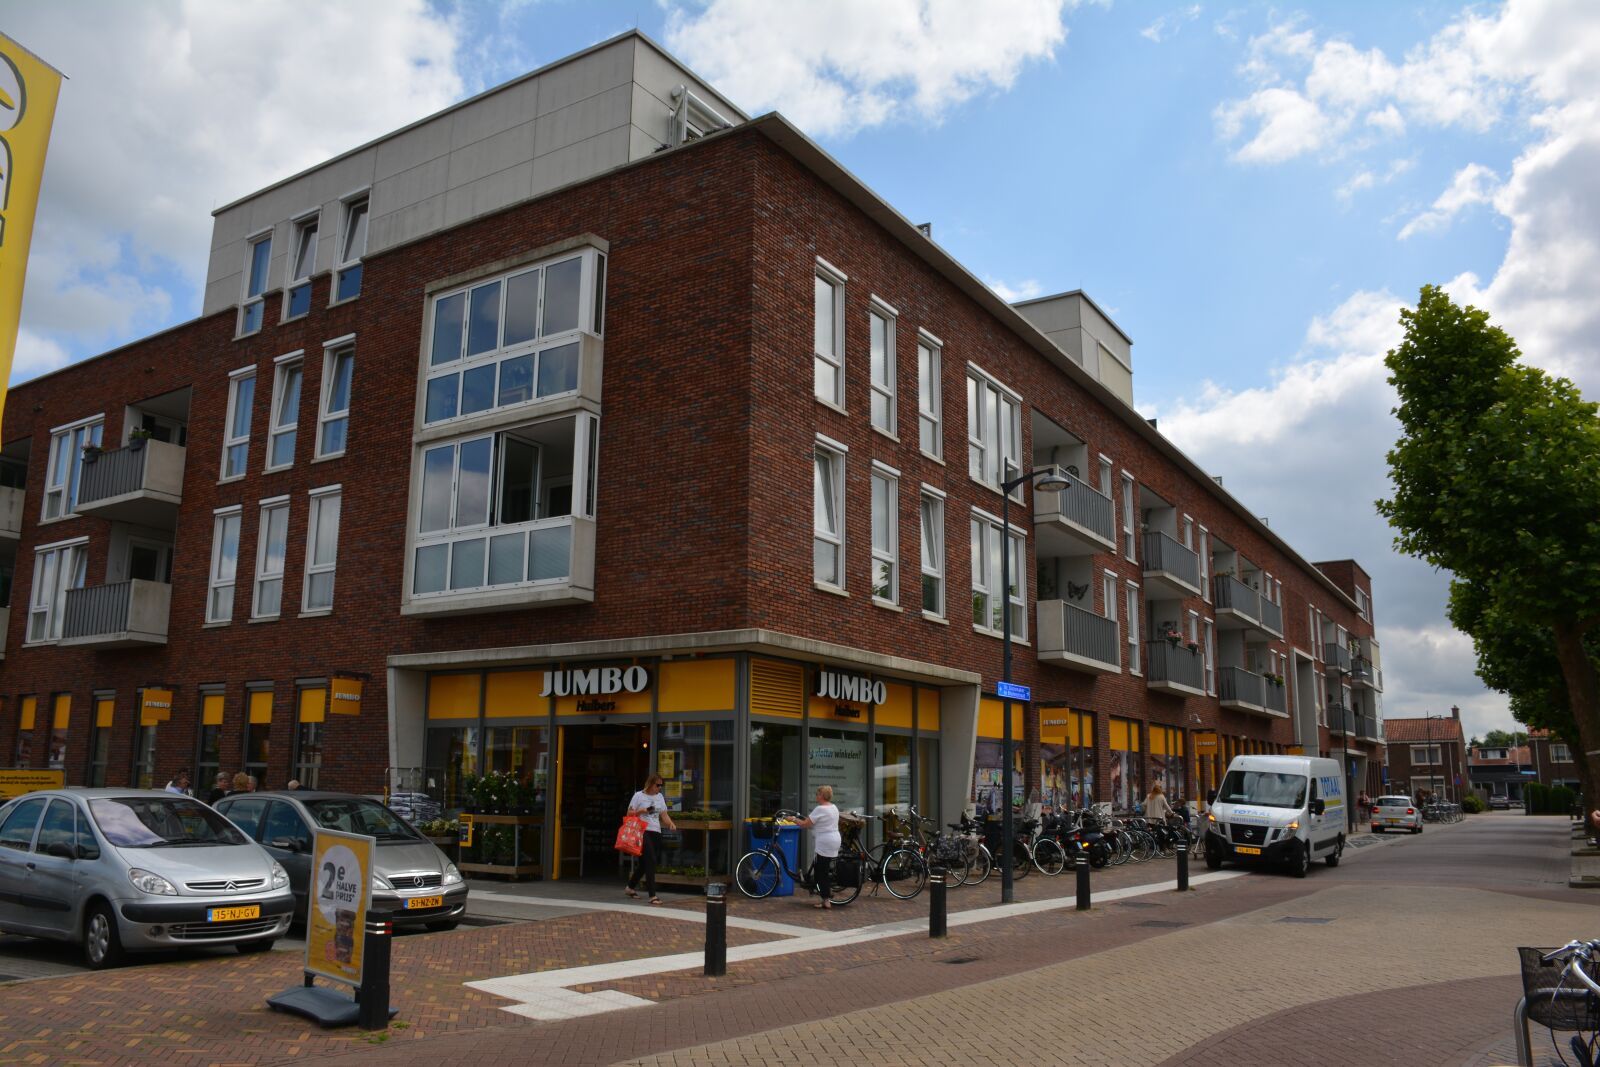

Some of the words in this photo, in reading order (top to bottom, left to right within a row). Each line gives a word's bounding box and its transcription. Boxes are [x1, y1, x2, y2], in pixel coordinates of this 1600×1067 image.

[539, 665, 648, 697] JUMBO
[817, 671, 887, 705] JUMBO
[335, 692, 360, 701] JUMBO
[144, 700, 171, 708] JUMBO
[1043, 719, 1068, 727] JUMBO
[834, 748, 862, 760] winkelen?
[336, 880, 357, 895] HALVE
[215, 907, 256, 920] 15-NJ-GV
